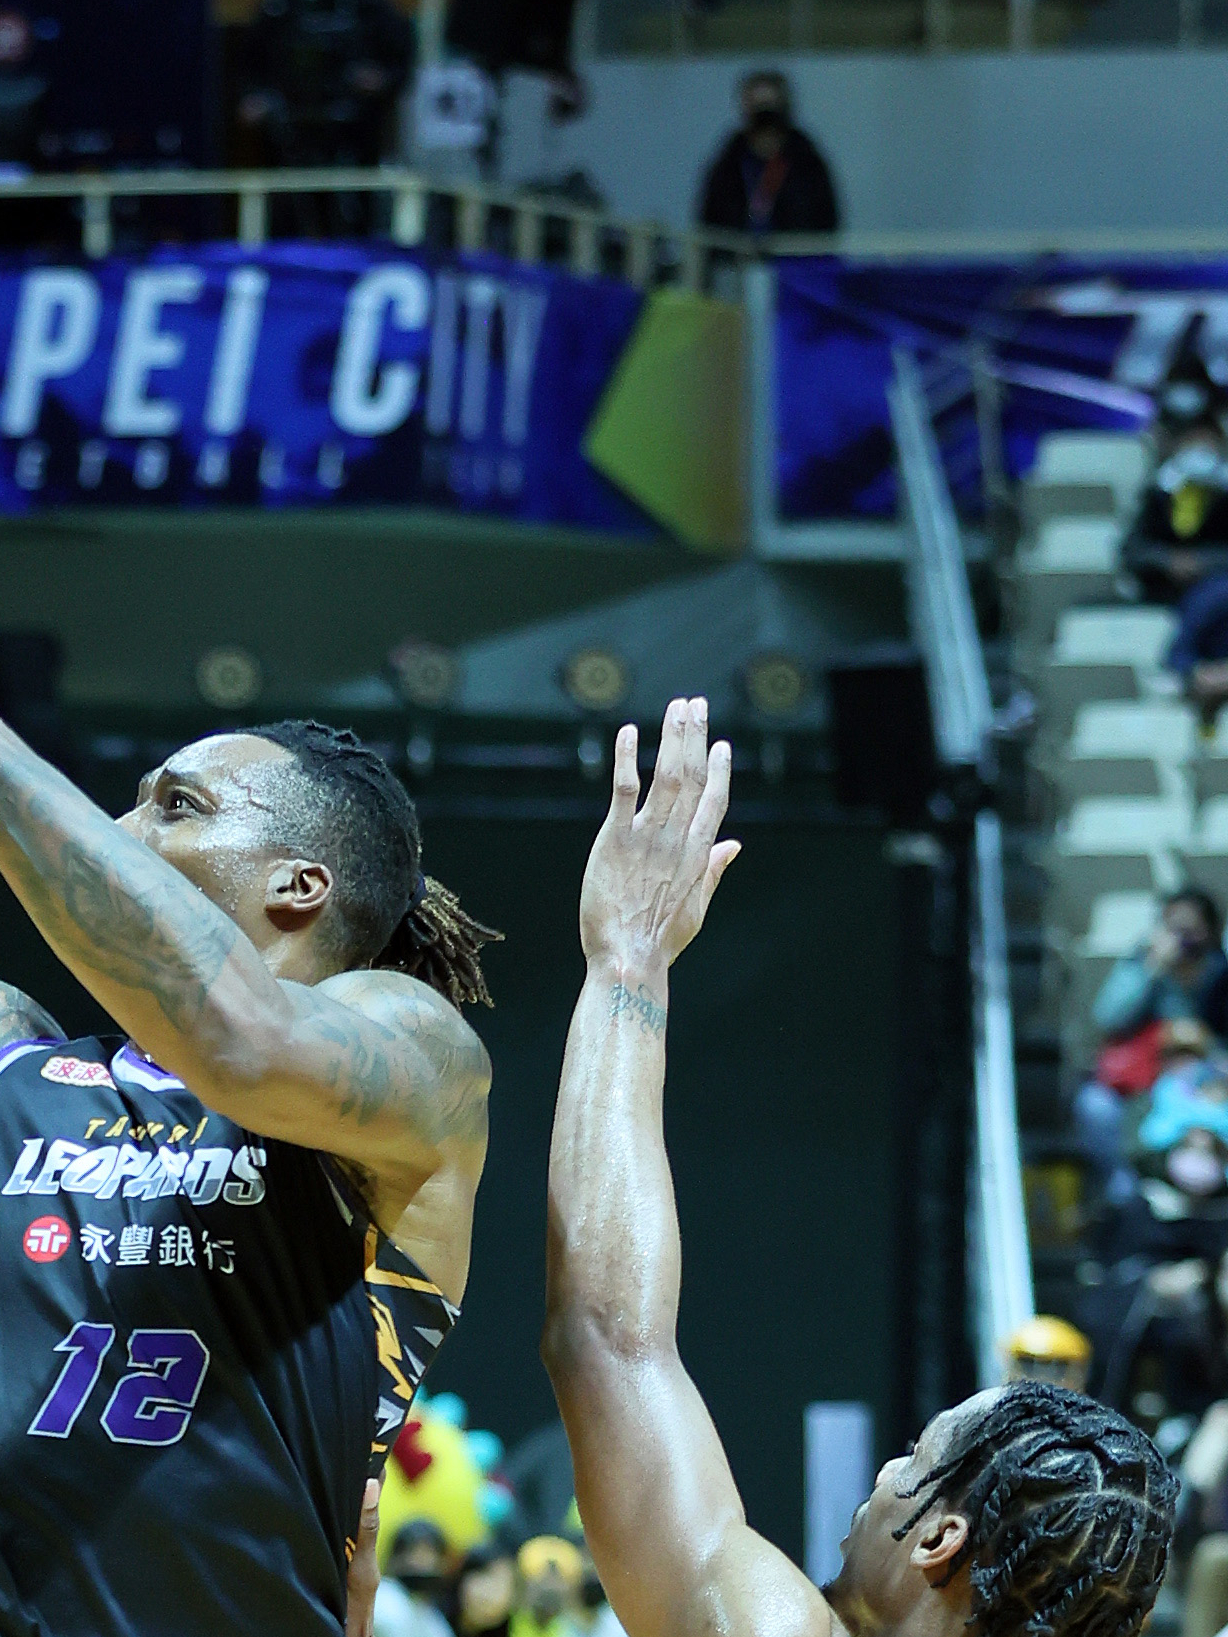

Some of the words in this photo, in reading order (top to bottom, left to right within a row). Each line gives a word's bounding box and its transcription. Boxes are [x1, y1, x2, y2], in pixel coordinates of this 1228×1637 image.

[78, 1221, 237, 1275] 永豐銀行
[26, 1321, 211, 1447] 12
